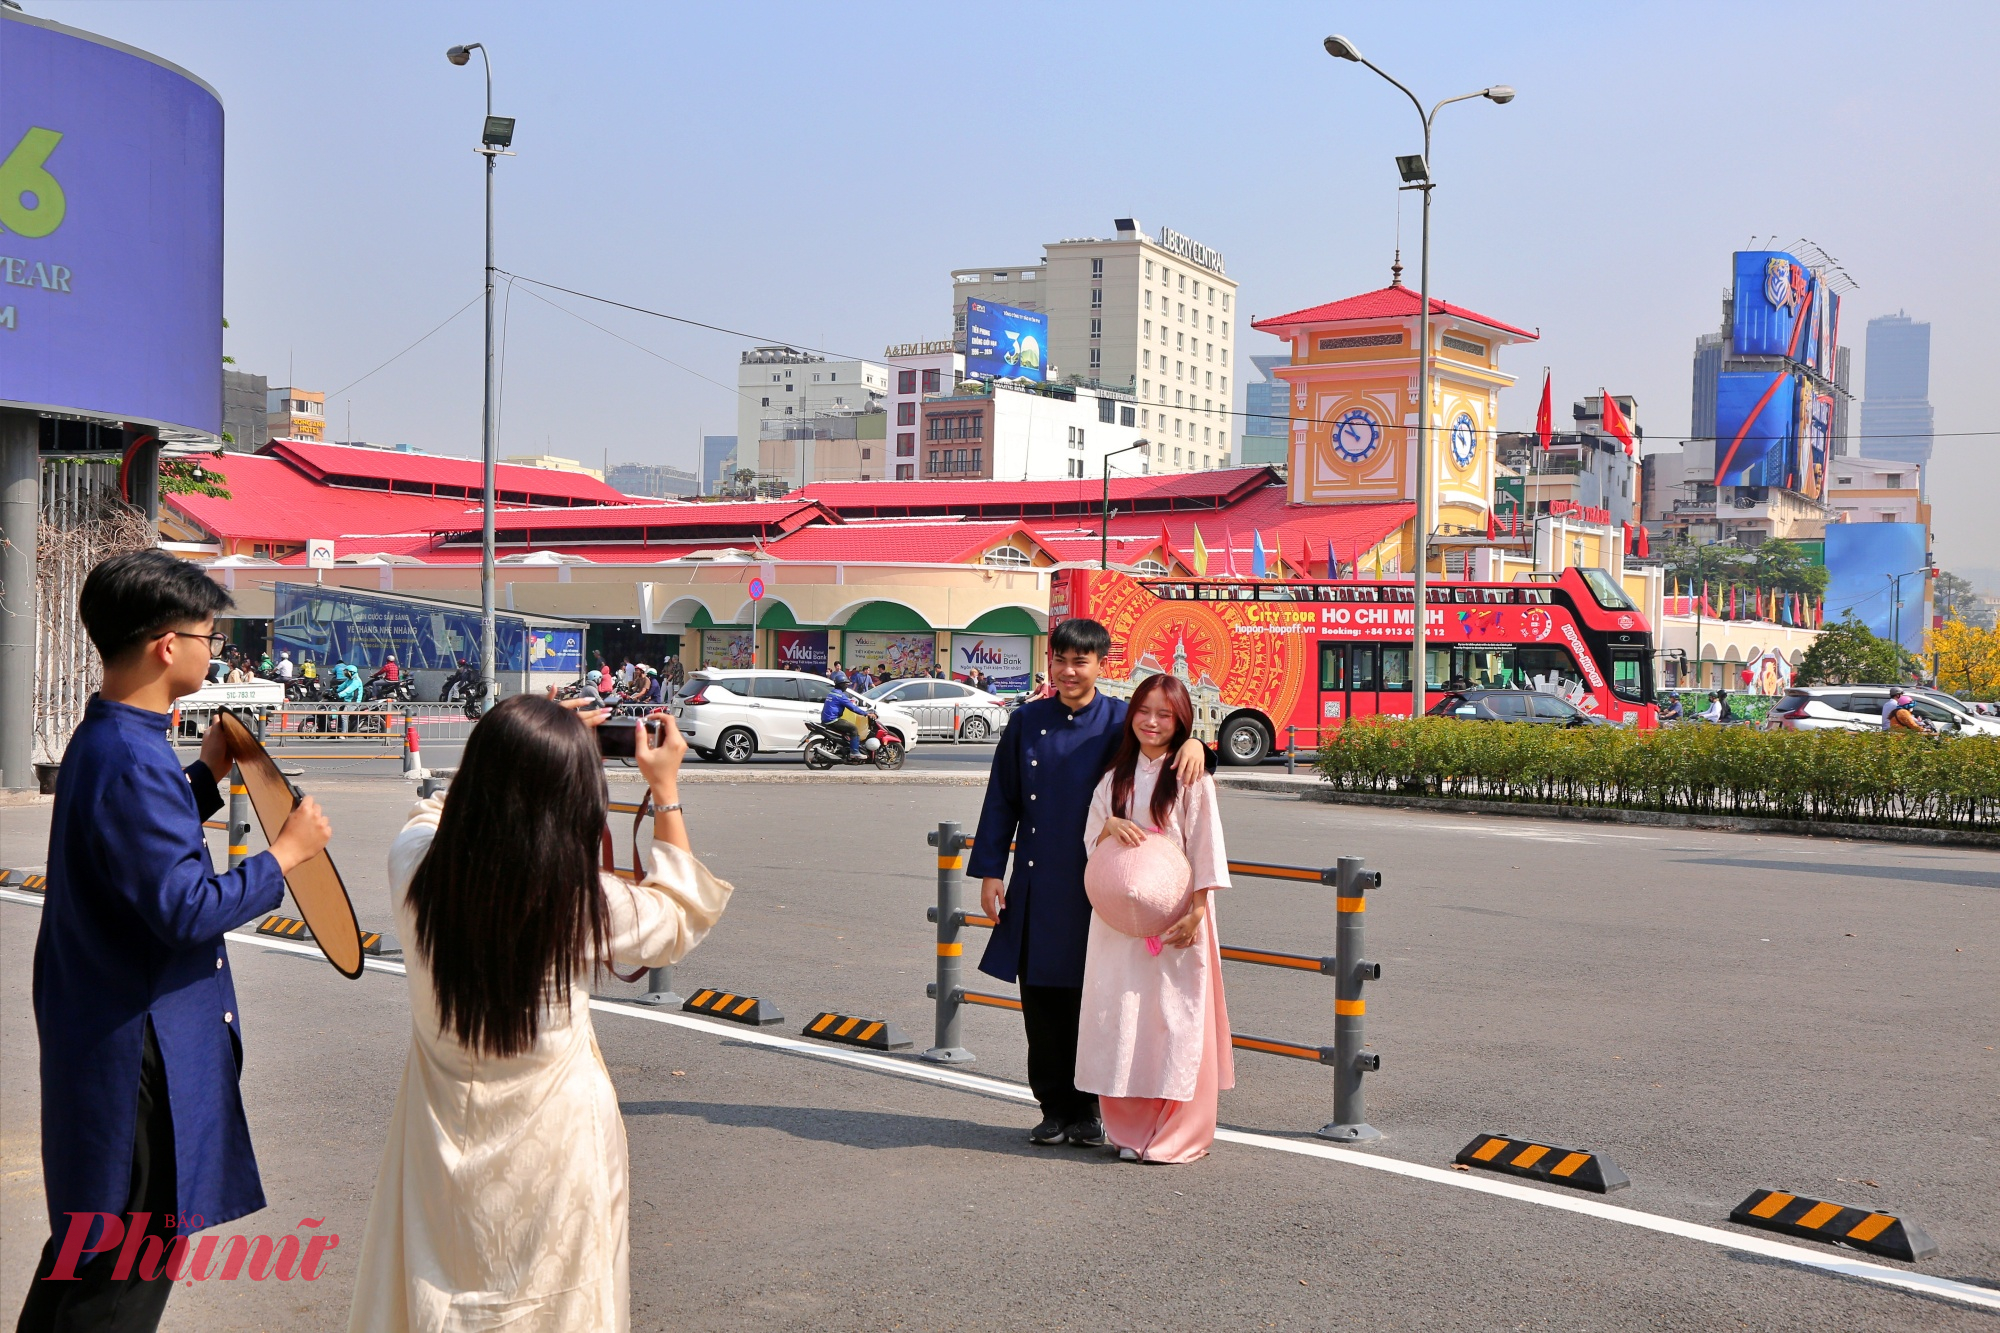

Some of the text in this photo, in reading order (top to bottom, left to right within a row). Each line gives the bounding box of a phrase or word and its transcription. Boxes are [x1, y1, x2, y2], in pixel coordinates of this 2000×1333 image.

[0, 126, 66, 238] 6
[1162, 226, 1225, 274] LIBERTY CENTRAL
[884, 340, 956, 357] A&EM HOTEL
[299, 426, 320, 434] HOTEL
[1584, 504, 1611, 525] THÀNH
[1284, 611, 1316, 622] TOUR
[1322, 608, 1351, 624] HO
[1354, 608, 1389, 624] CHI
[1235, 623, 1316, 635] hopon-hopoff.vn
[1322, 627, 1362, 636] Booking:
[1365, 628, 1383, 636] +84
[1385, 628, 1403, 636] 913
[1433, 628, 1445, 636] 12
[782, 639, 812, 660] Vikki
[961, 639, 1002, 665] Vikki
